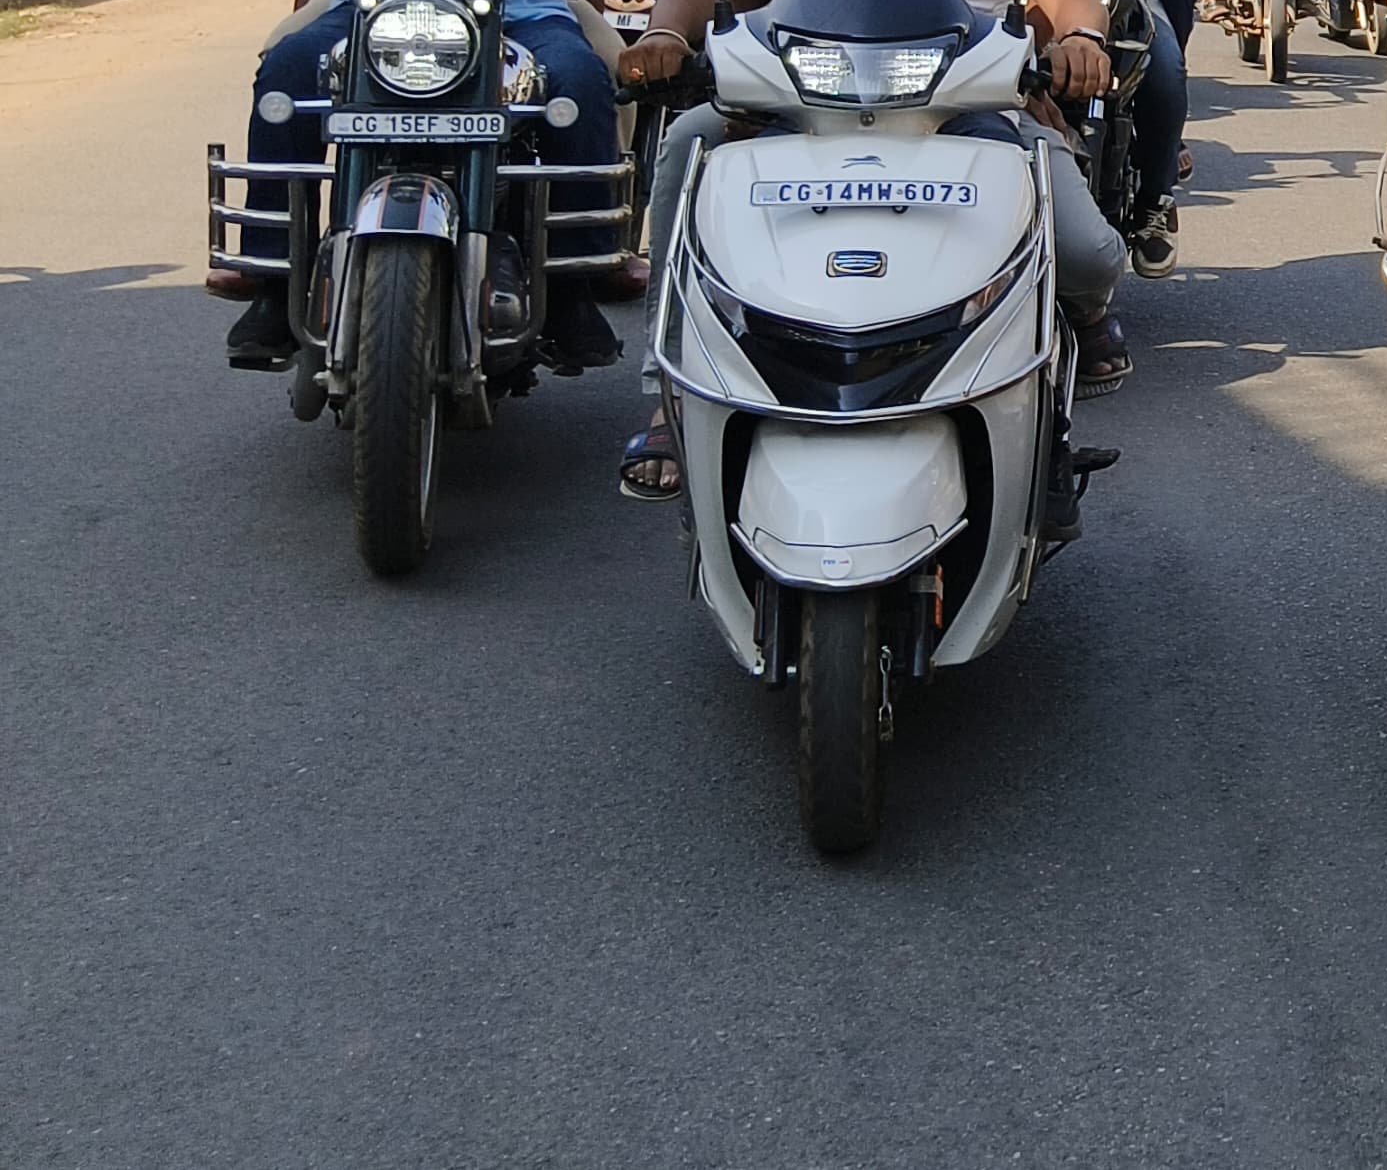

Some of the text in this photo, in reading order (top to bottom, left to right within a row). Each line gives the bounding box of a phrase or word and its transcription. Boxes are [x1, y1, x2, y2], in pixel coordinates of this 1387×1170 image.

[352, 116, 502, 133] CG 15EF 9008
[779, 183, 972, 203] CG 14MW 6073
